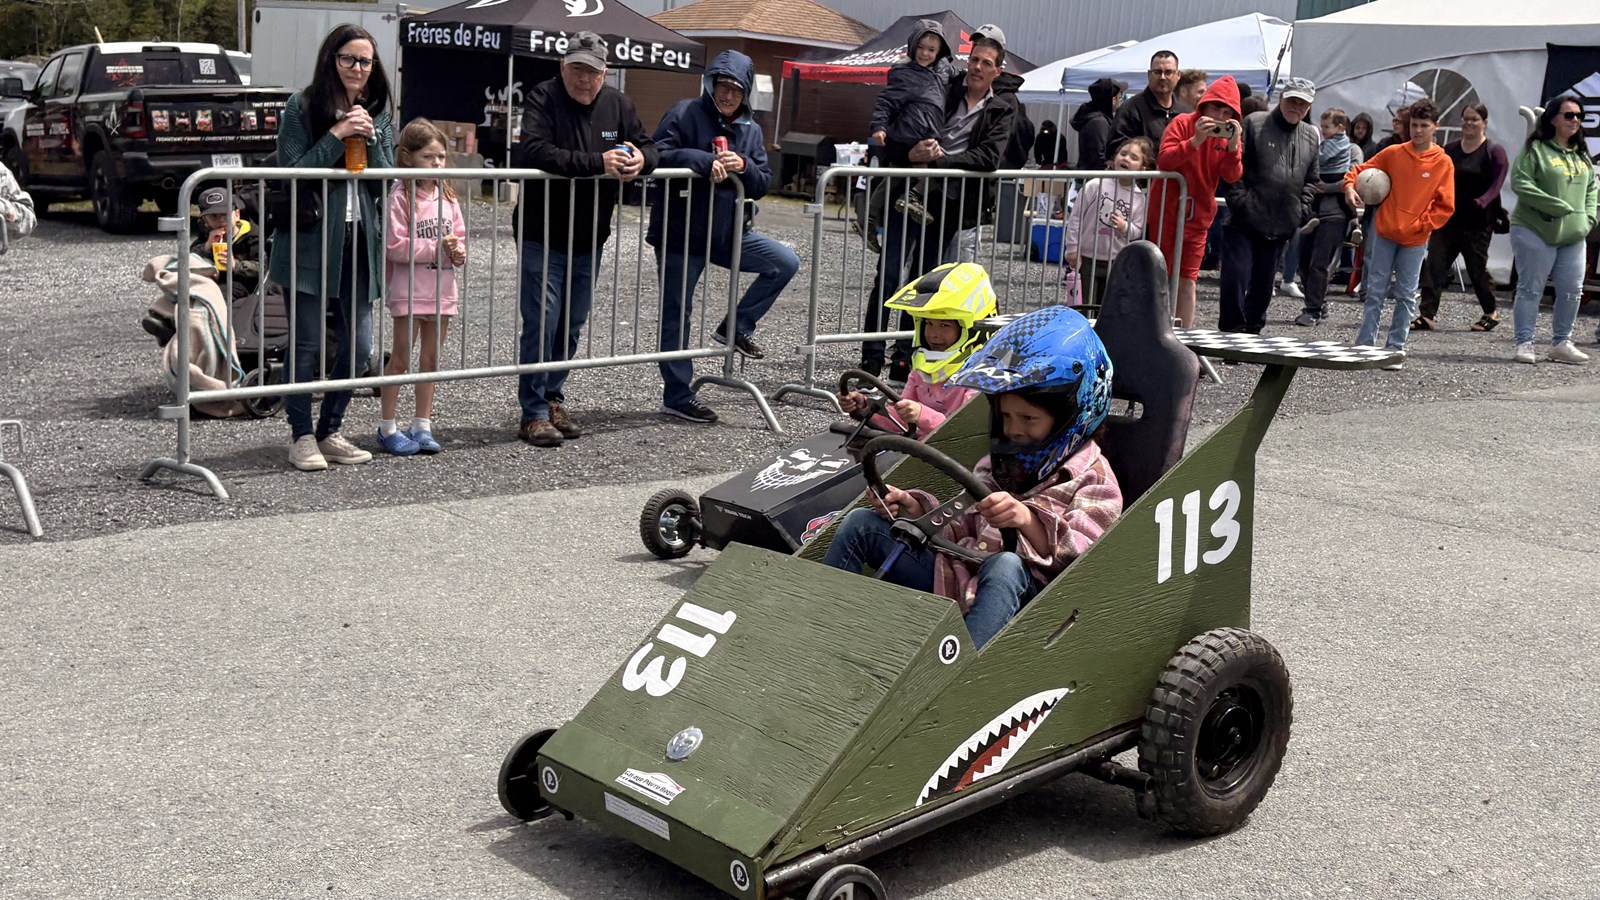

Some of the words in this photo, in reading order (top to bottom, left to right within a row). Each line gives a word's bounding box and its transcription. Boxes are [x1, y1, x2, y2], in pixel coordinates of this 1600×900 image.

[408, 22, 451, 45] Frères
[454, 23, 472, 47] de
[474, 25, 501, 49] Feu
[615, 37, 644, 62] de
[650, 43, 691, 69] Feu
[1154, 480, 1241, 584] 113
[622, 602, 737, 697] 113
